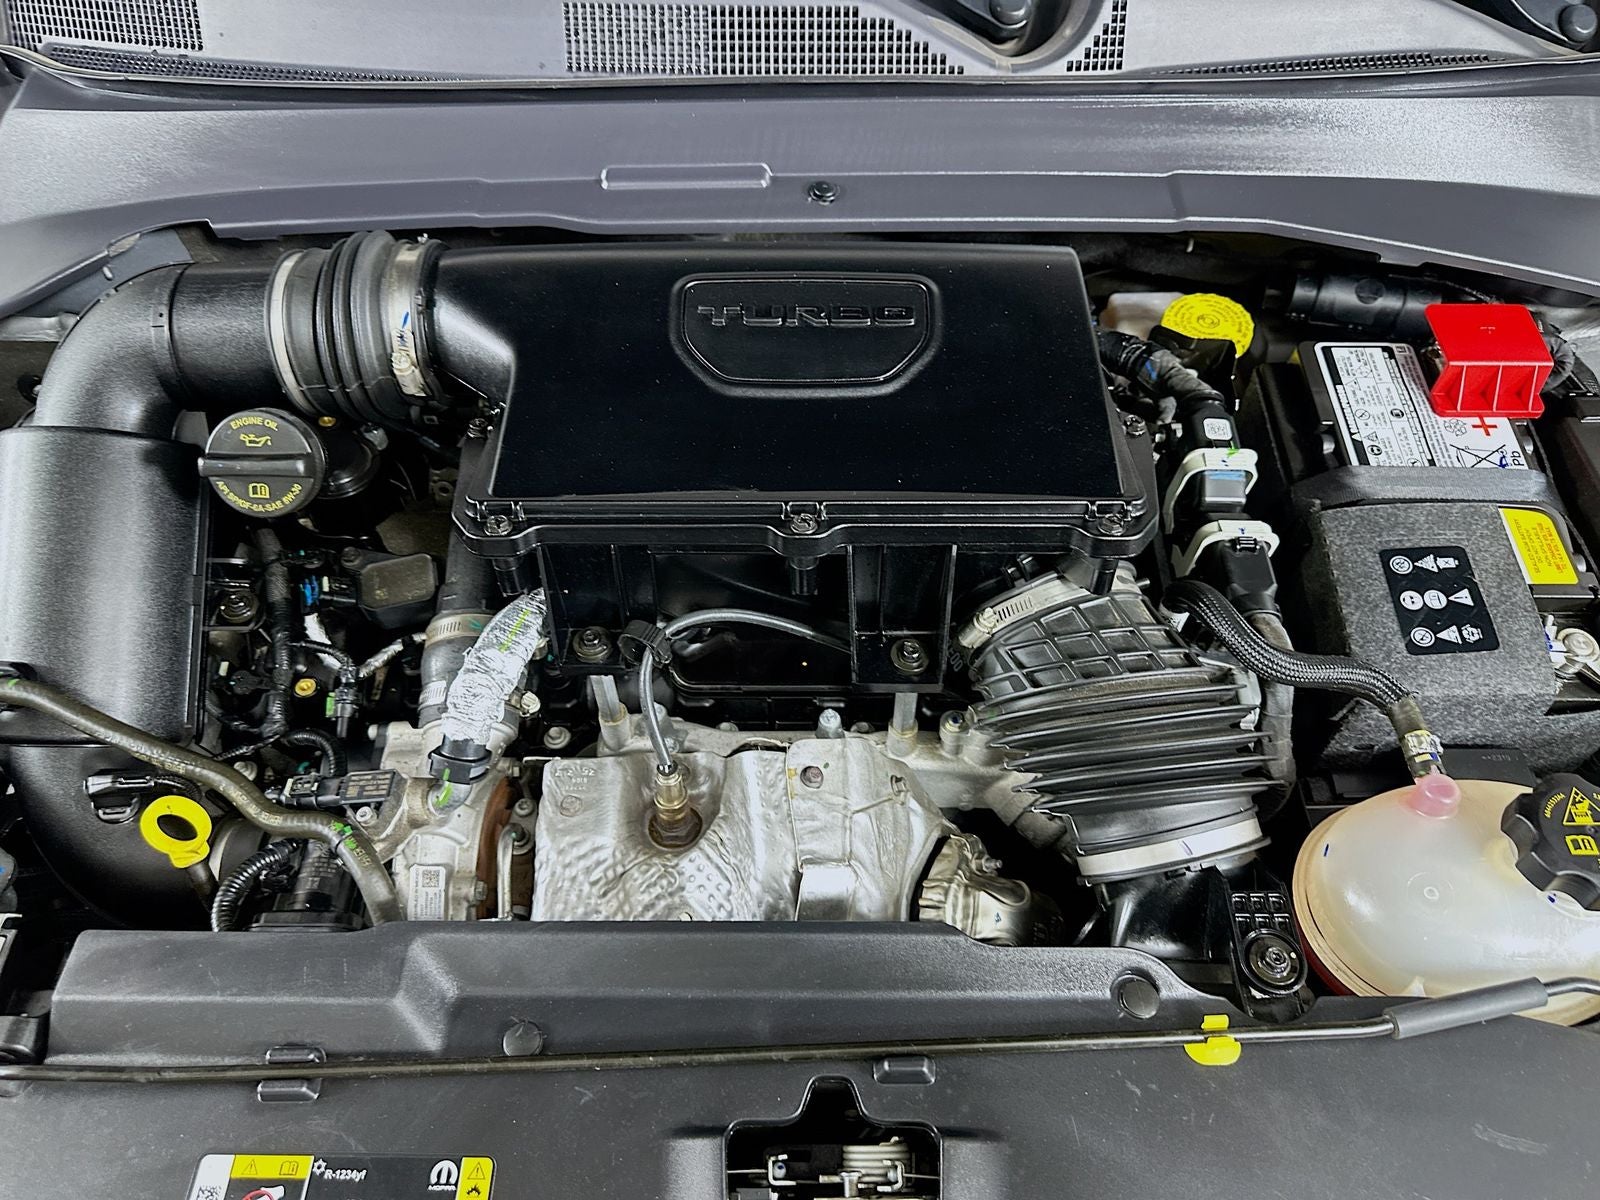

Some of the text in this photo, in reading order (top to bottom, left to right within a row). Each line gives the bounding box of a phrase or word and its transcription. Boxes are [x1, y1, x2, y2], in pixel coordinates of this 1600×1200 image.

[697, 304, 915, 327] TURBO
[230, 416, 279, 432] ENGINE OIL
[1510, 450, 1525, 466] Pb
[324, 1168, 367, 1182] R-1234yf
